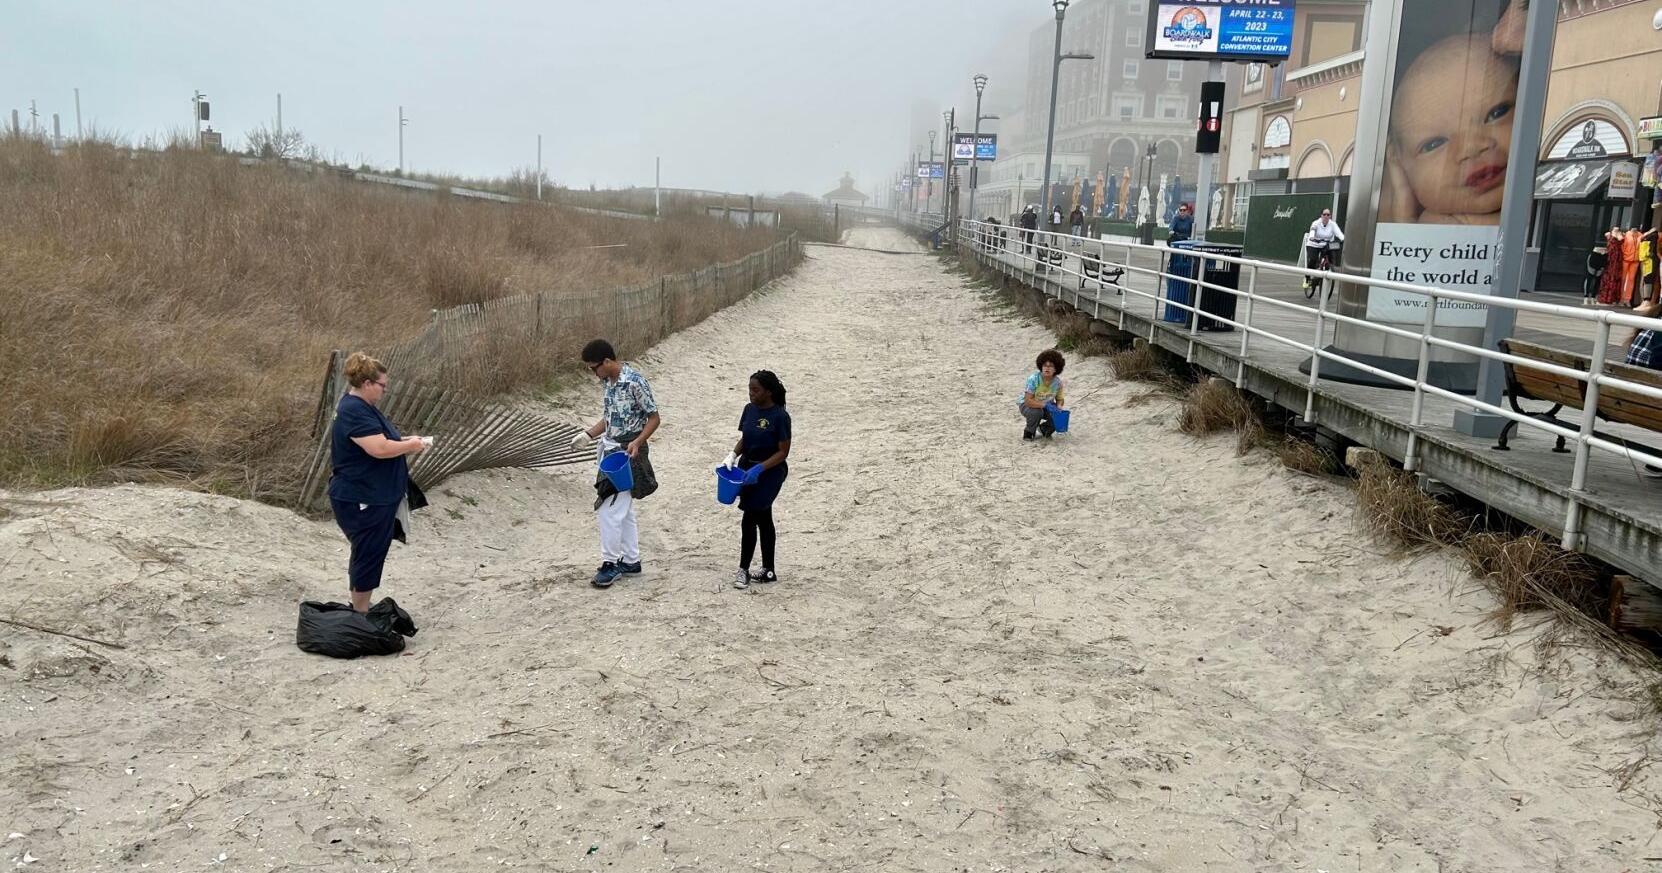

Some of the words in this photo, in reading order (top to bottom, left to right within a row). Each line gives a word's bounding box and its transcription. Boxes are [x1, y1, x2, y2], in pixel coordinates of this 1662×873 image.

[1229, 9, 1252, 18] APRIL
[1256, 10, 1266, 18] 22
[1272, 11, 1284, 20] 23,
[1245, 21, 1267, 31] 2023
[1231, 35, 1262, 43] ATLANTIC
[1220, 43, 1261, 51] CONVENTION
[1378, 241, 1434, 263] Every
[1439, 243, 1489, 260] child
[1386, 266, 1416, 282] the
[1422, 269, 1478, 285] world
